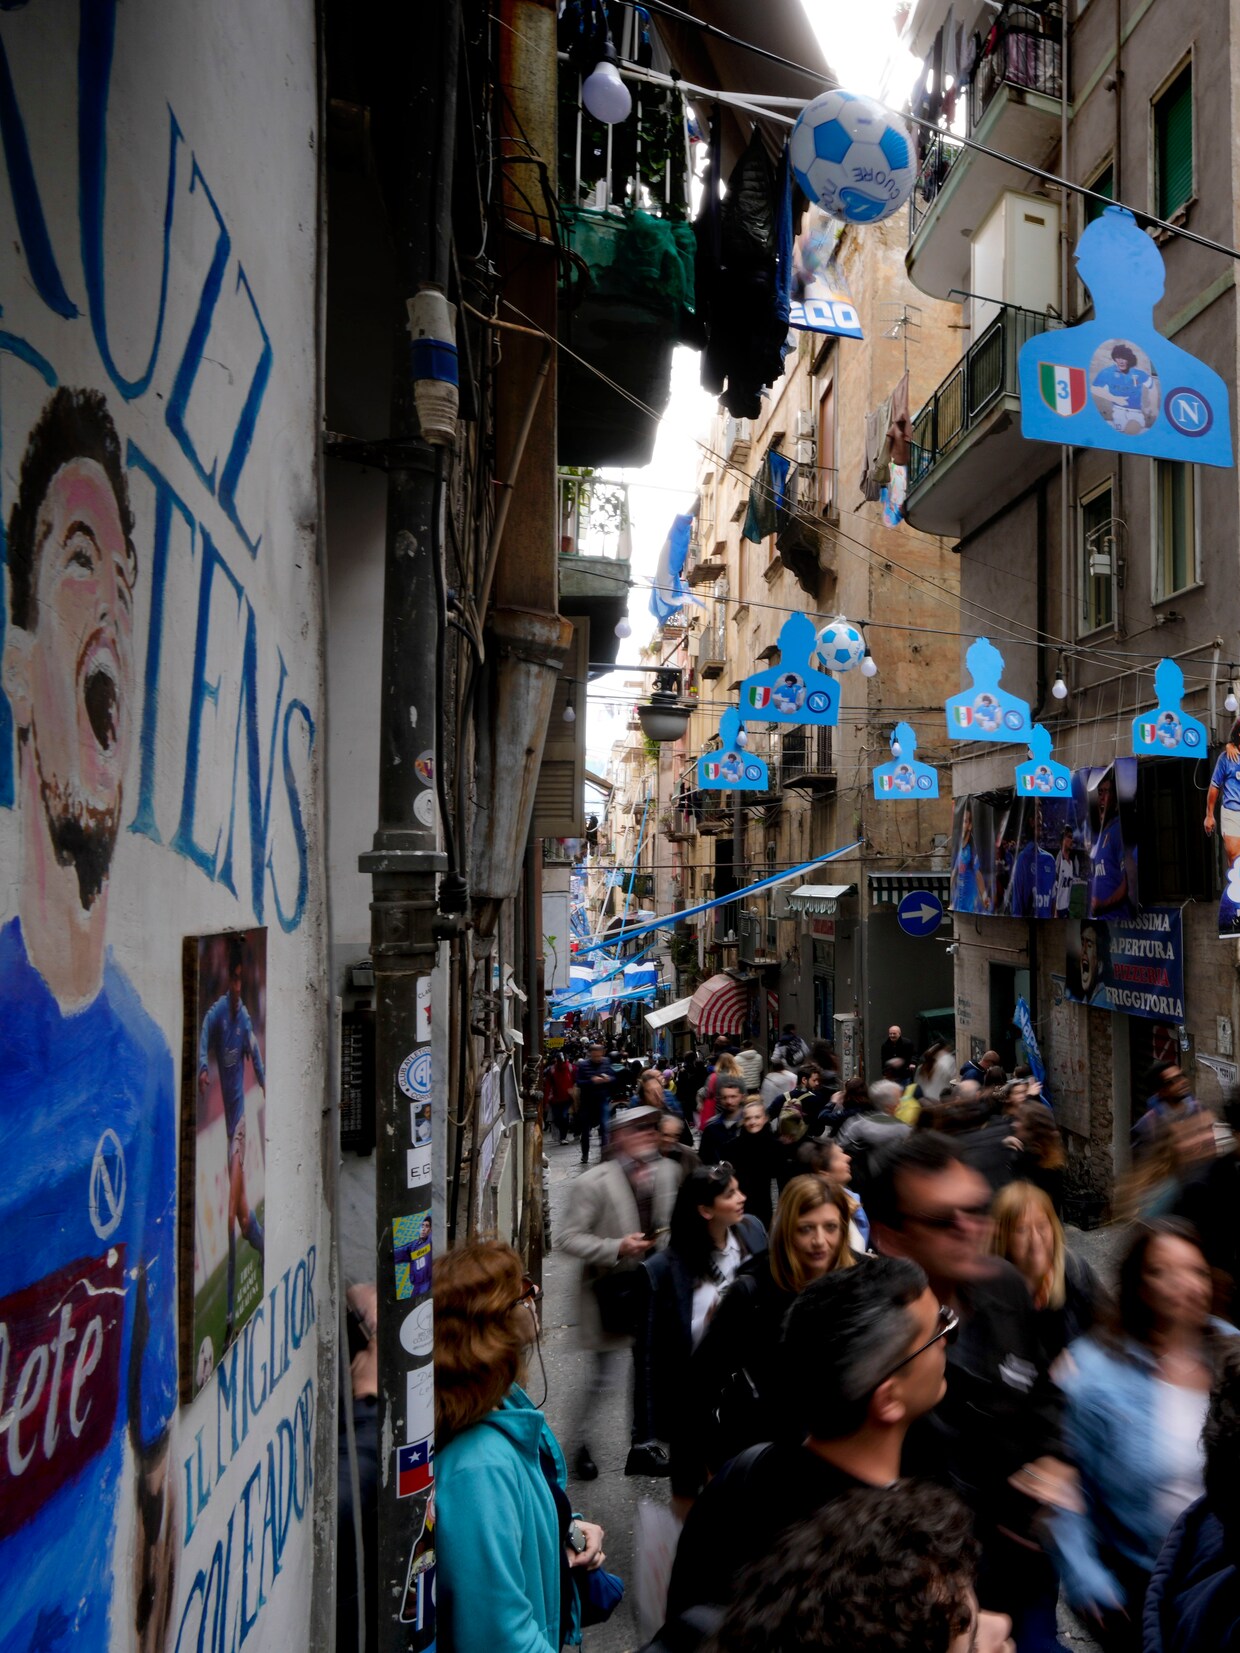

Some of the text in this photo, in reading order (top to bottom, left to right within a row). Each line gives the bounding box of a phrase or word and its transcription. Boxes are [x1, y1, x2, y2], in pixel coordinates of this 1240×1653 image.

[1056, 380, 1069, 400] 3
[1177, 399, 1199, 425] N
[813, 696, 825, 708] N
[1110, 938, 1176, 960] APERTURA
[1113, 962, 1171, 988] PIZZERIA
[1105, 987, 1184, 1018] FRIGGITORIA
[399, 1068, 407, 1087] CLUB
[215, 1245, 317, 1462] MIGLIOR
